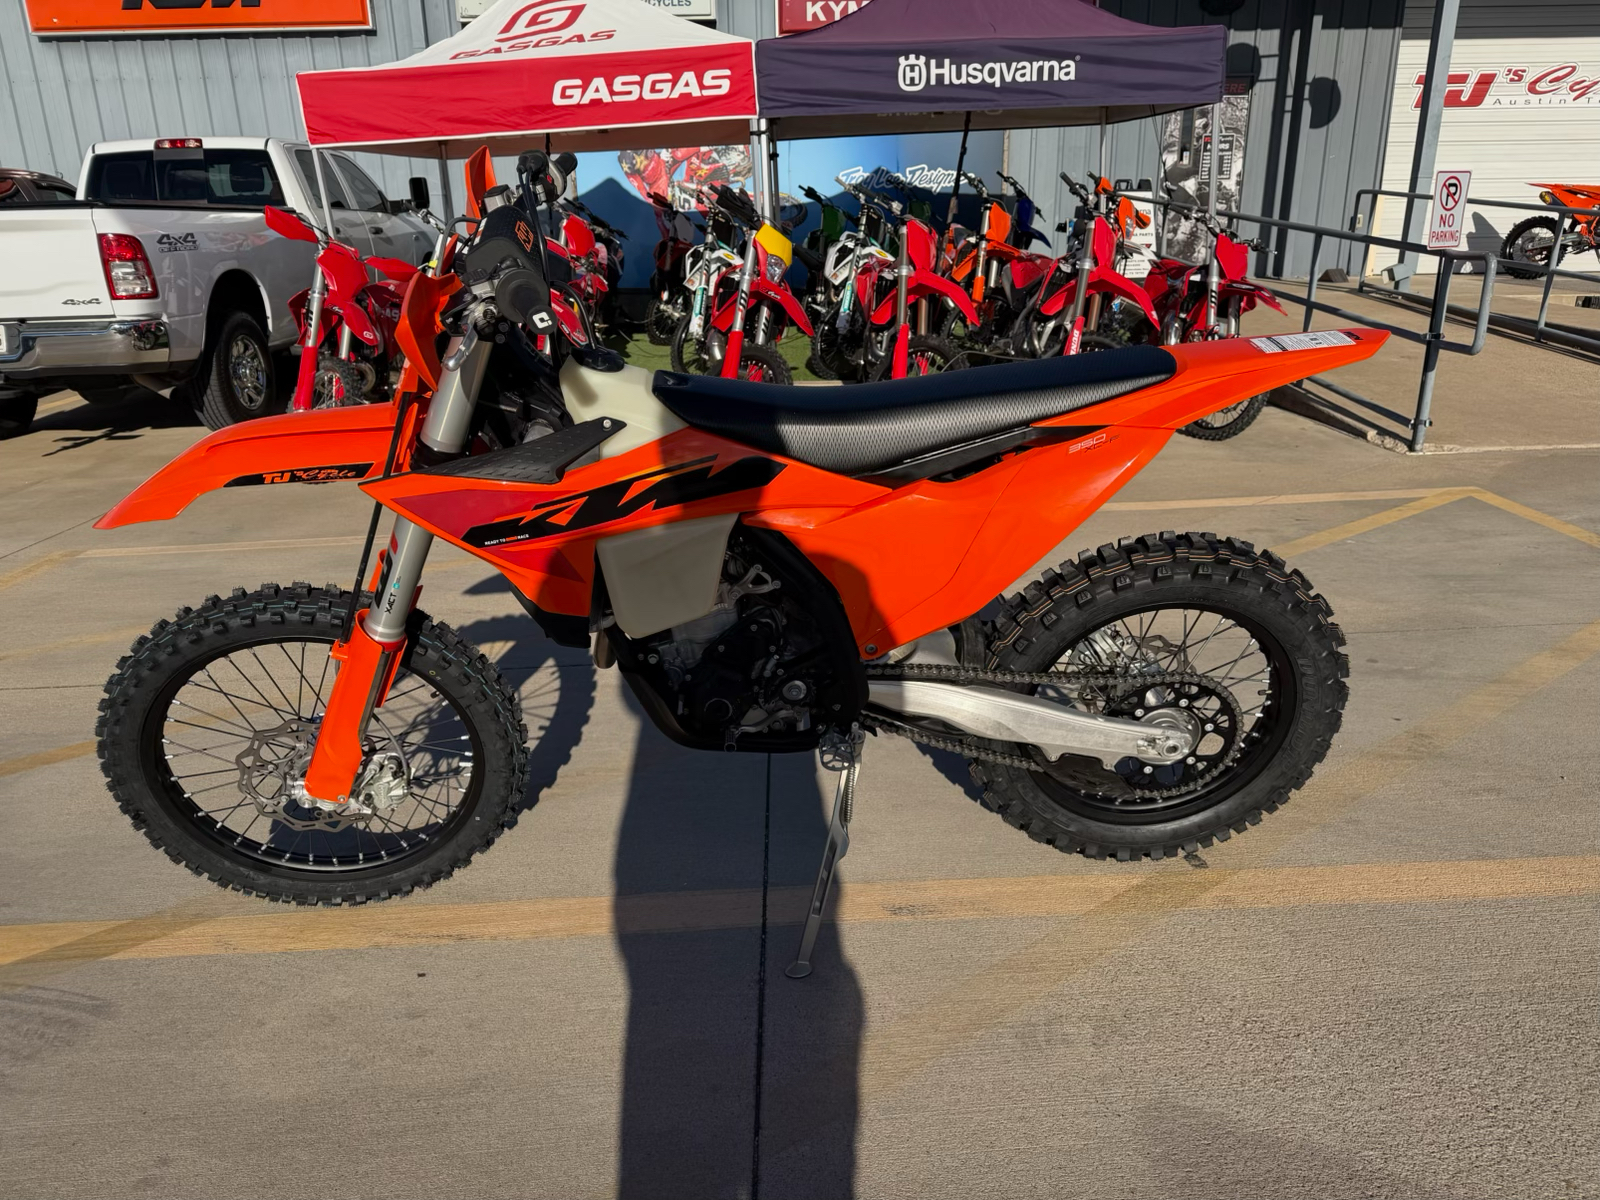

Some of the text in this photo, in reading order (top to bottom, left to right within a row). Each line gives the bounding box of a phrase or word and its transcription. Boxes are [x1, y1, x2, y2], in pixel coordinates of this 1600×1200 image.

[449, 30, 616, 60] GASGAS
[930, 58, 1076, 88] Husqvarna
[552, 69, 731, 106] GASGAS
[1493, 97, 1567, 105] Austin
[1439, 213, 1455, 228] NO
[1431, 230, 1459, 243] PARKING
[384, 592, 397, 615] XACT
